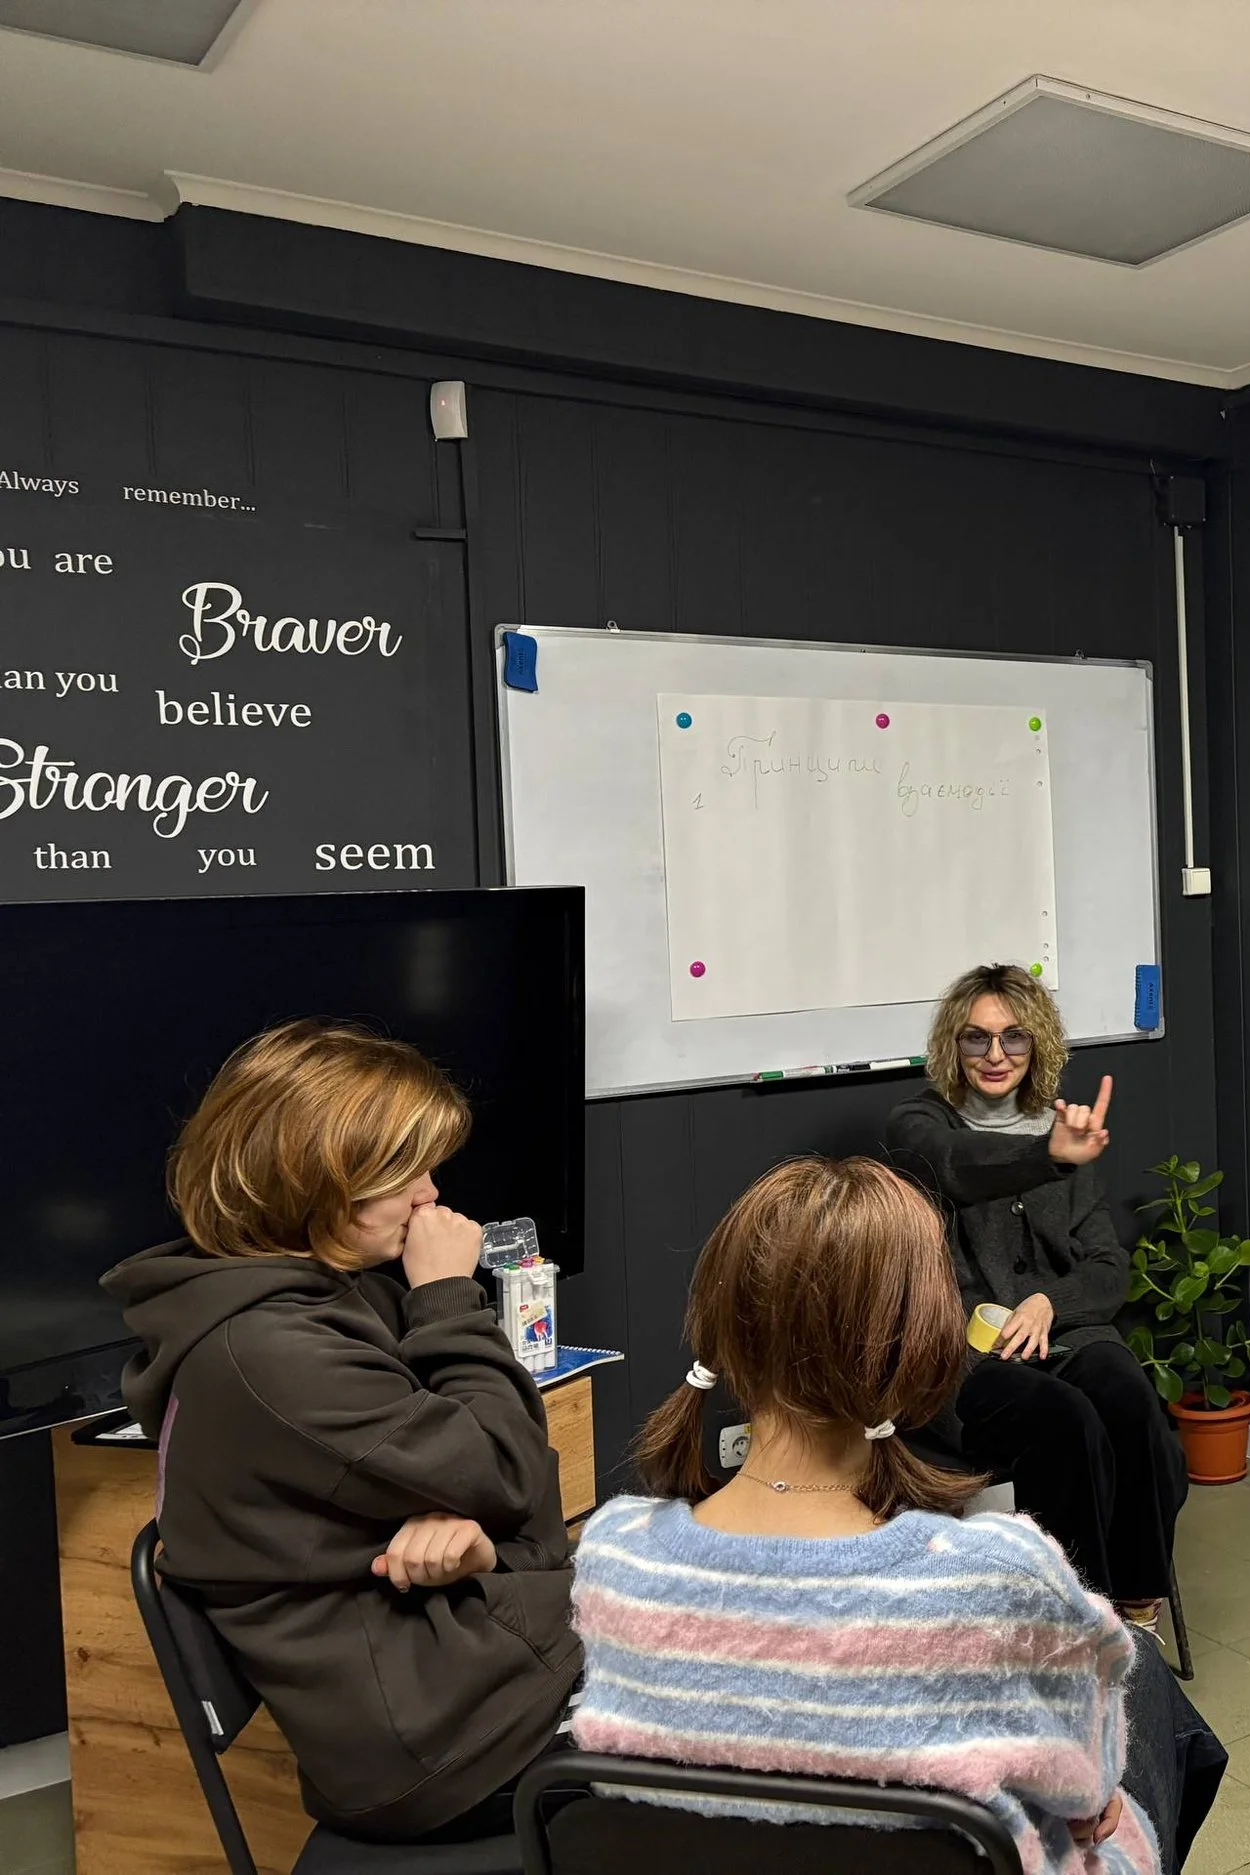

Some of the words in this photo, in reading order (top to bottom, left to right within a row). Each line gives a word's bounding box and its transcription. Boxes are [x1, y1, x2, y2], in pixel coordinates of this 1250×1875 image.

[0, 471, 79, 498] Always
[123, 484, 256, 512] remember...
[54, 552, 114, 575] are
[178, 582, 403, 666] Braver
[0, 670, 47, 691] an
[55, 671, 119, 698] you
[154, 689, 313, 728] believe
[720, 730, 881, 810] Принципи
[692, 792, 704, 810] 1
[33, 843, 112, 870] than
[197, 848, 258, 874] you
[314, 843, 437, 871] seem
